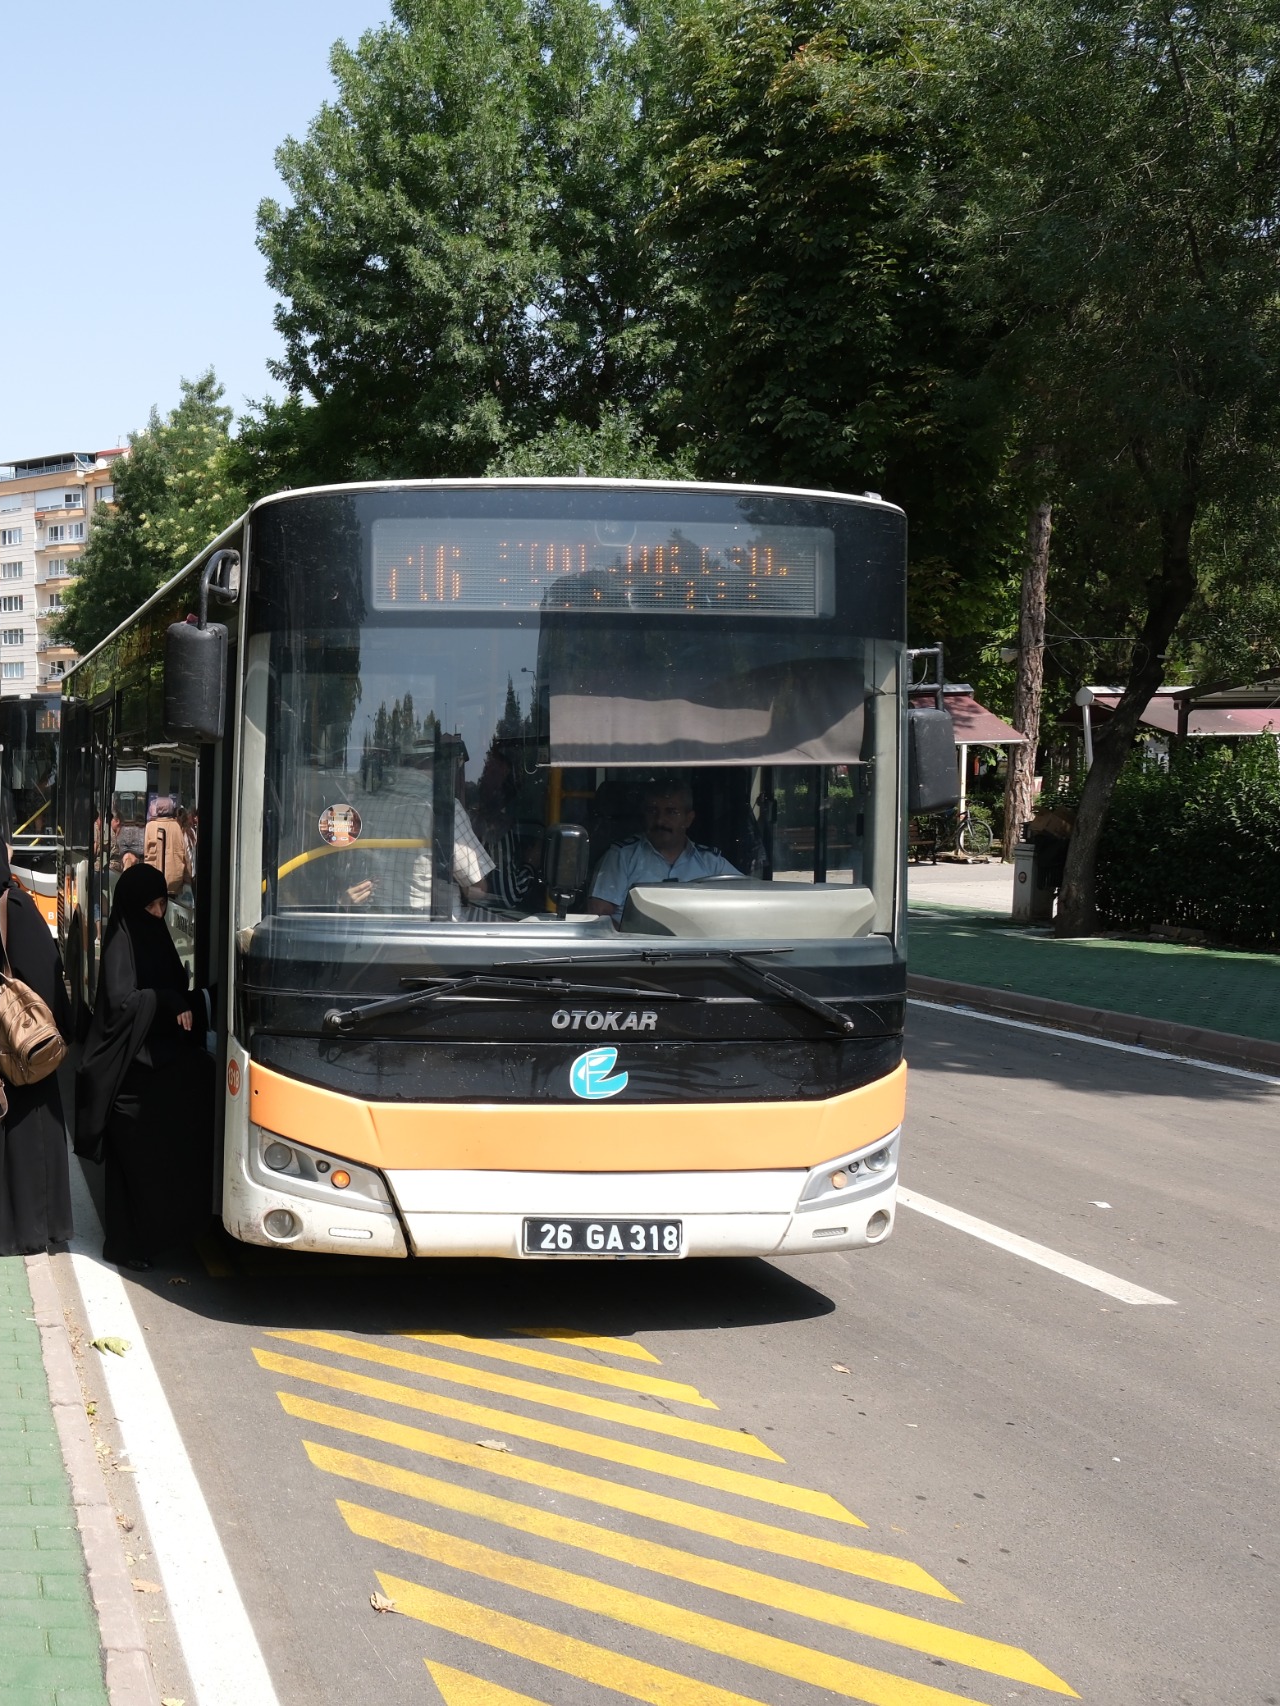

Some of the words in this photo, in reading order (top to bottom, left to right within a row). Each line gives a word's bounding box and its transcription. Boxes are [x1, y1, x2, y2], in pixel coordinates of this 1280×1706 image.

[551, 1009, 658, 1031] OTOKAR
[540, 1223, 573, 1250] 26
[586, 1224, 624, 1250] GA
[630, 1224, 678, 1251] 318
